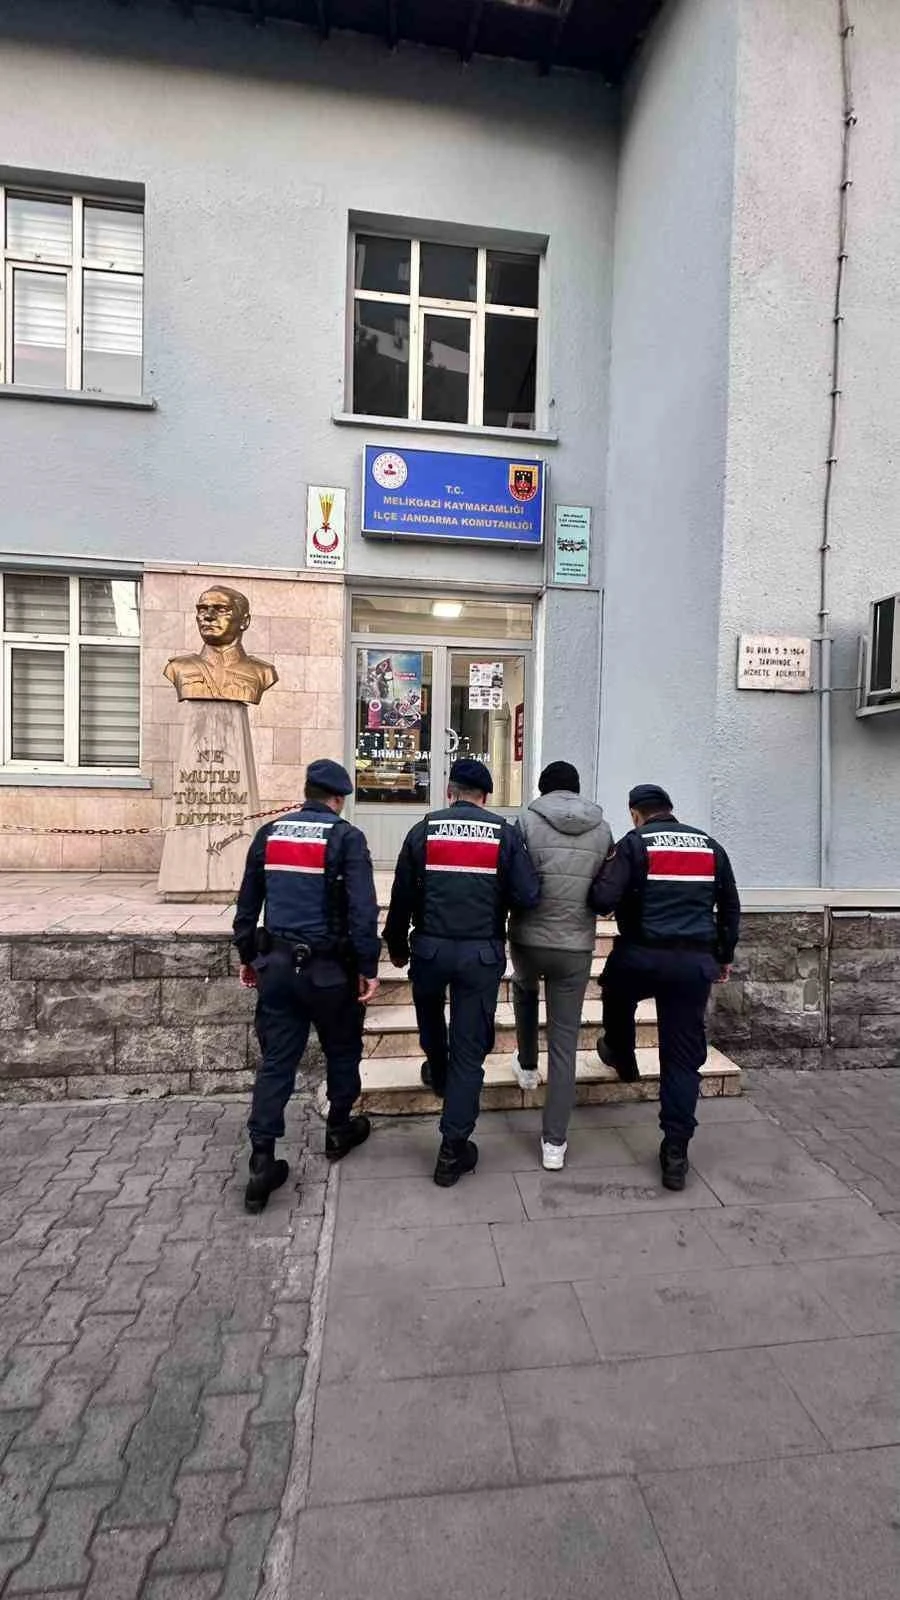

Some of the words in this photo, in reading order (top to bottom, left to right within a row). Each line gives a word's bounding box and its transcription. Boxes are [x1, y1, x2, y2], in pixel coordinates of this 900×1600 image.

[444, 485, 464, 495] T.C.
[383, 495, 441, 508] MELİKGAZİ
[444, 501, 524, 515] KAYMAKAMLIĞI
[373, 511, 398, 523] İLÇE
[400, 514, 458, 526] JANDARMA
[461, 518, 533, 530] KOMUTANLIĞI
[196, 749, 225, 764] NE
[179, 769, 241, 784] MUTLU
[173, 787, 248, 805] TÜRKÜM
[434, 823, 495, 838] JANDARMA
[652, 834, 708, 849] JANDARMA
